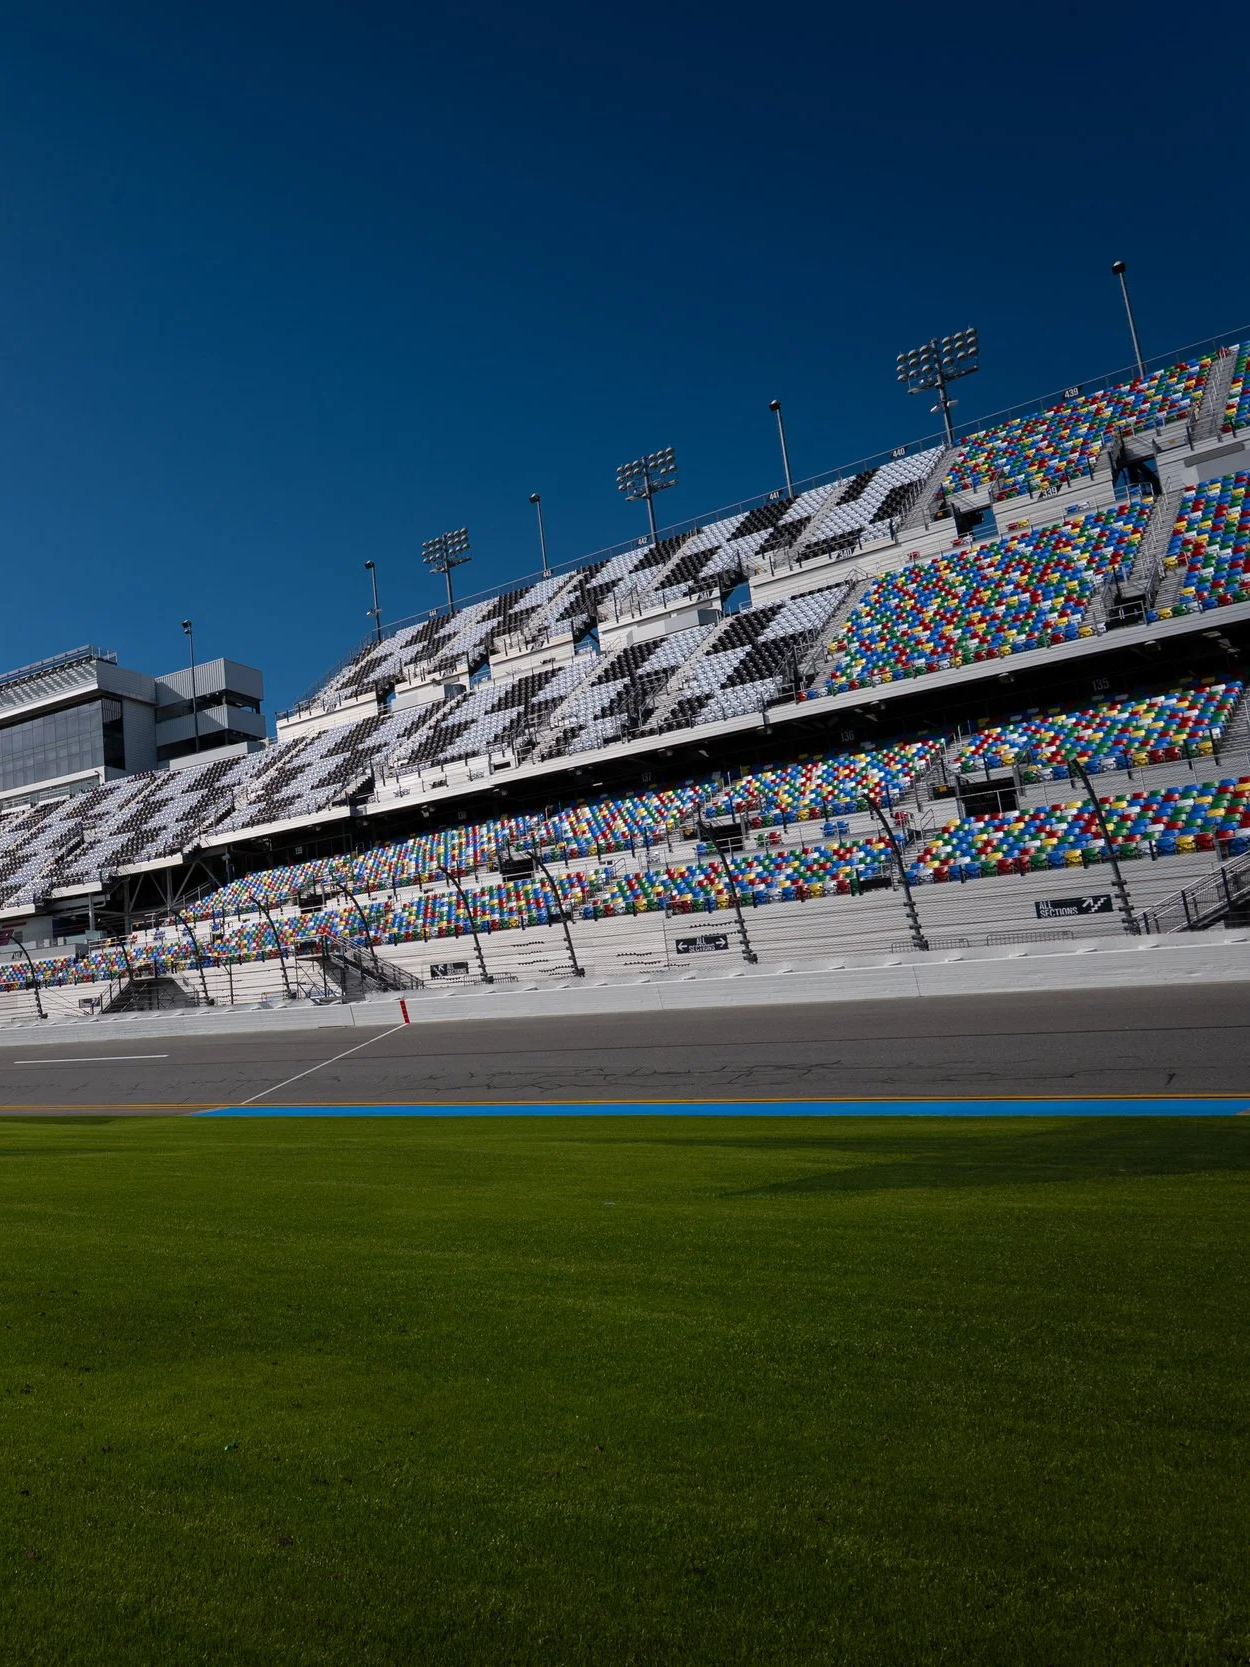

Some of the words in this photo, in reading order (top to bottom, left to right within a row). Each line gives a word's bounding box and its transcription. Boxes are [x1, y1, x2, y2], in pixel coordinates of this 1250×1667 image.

[1064, 387, 1079, 398] 439
[893, 447, 905, 457] 440
[770, 491, 780, 500] 441
[1041, 486, 1058, 498] 339
[1092, 677, 1110, 690] 135
[841, 730, 855, 742] 136
[1039, 900, 1053, 910] ALL
[1040, 906, 1079, 919] SECTIONS
